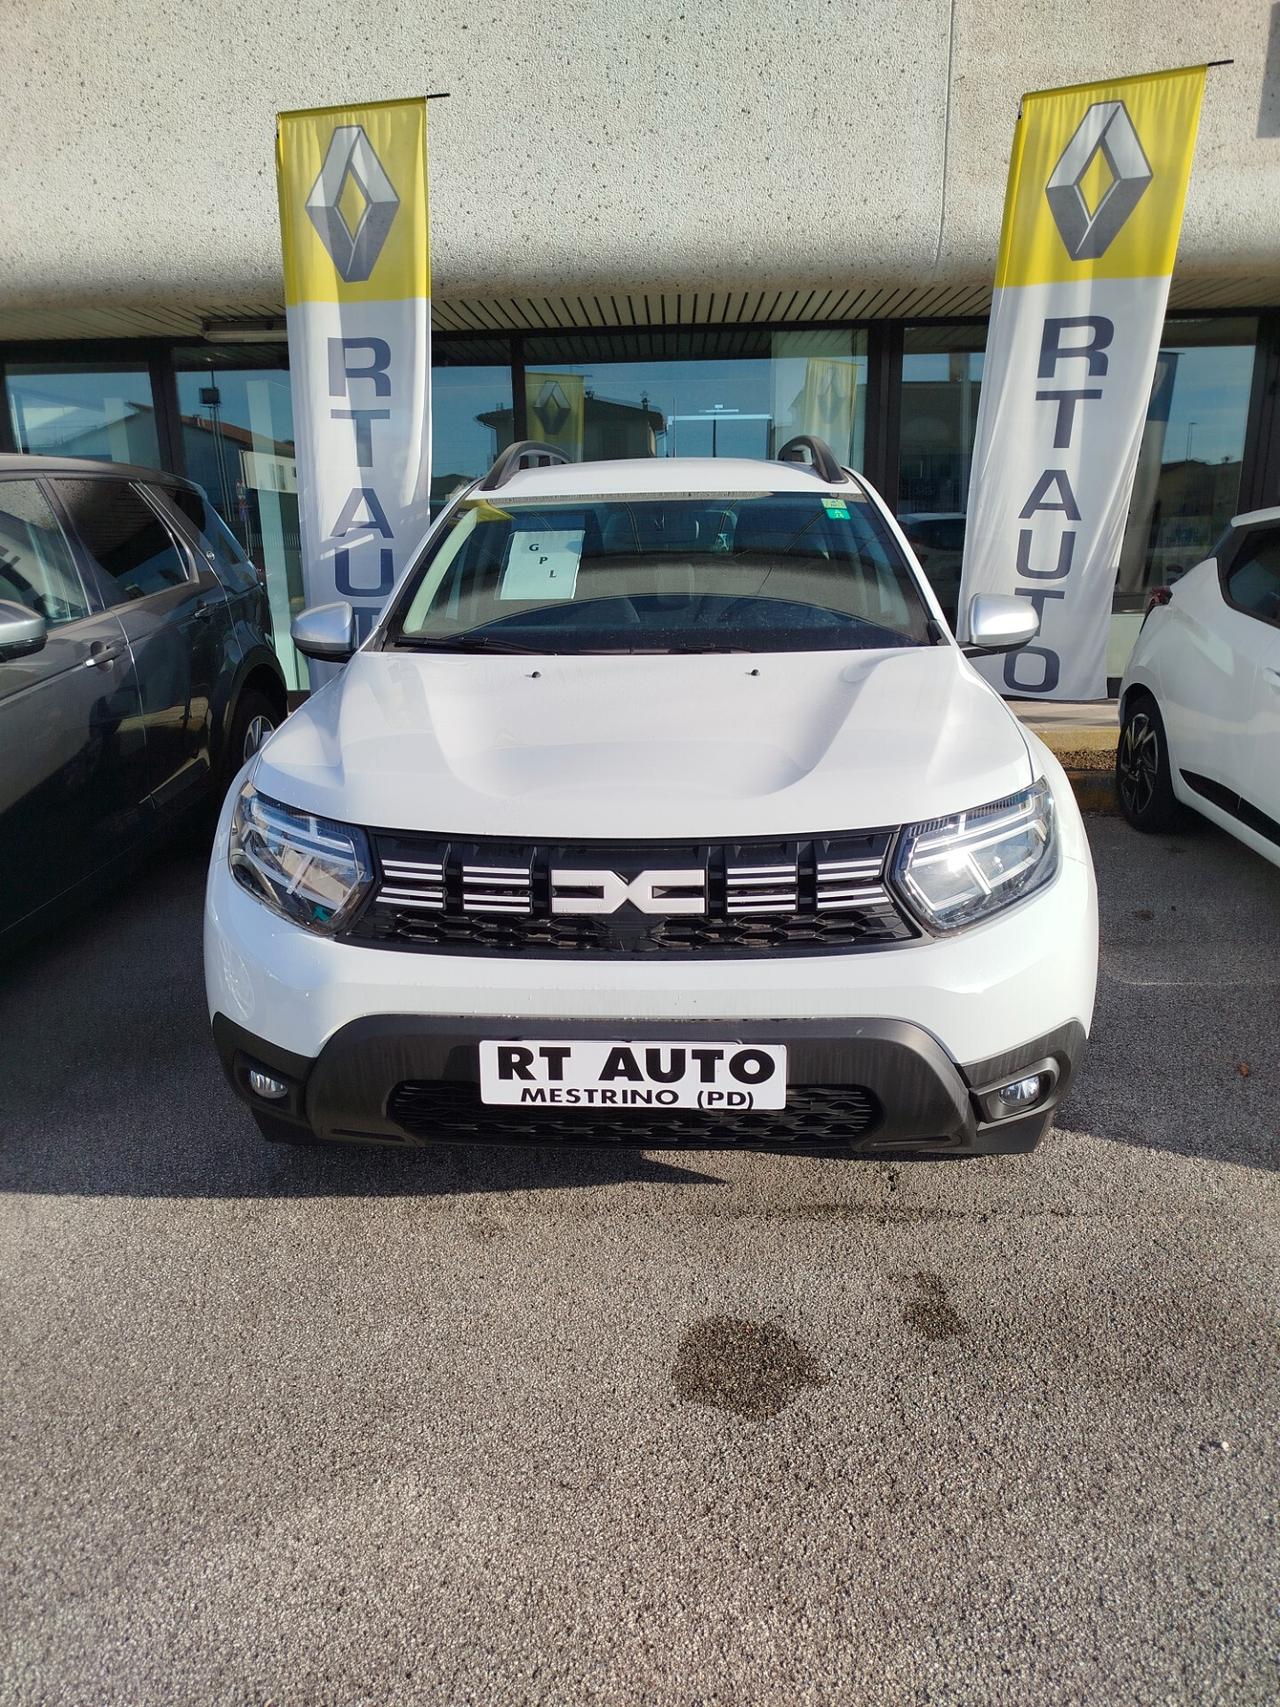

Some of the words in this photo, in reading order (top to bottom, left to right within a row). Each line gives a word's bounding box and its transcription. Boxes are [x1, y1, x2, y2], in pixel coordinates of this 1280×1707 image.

[327, 337, 391, 467] RT
[1036, 315, 1114, 448] RT
[497, 1046, 571, 1081] RT
[599, 1047, 775, 1085] AUTO
[521, 1087, 679, 1106] MESTRINO
[697, 1090, 753, 1110] (PD)
